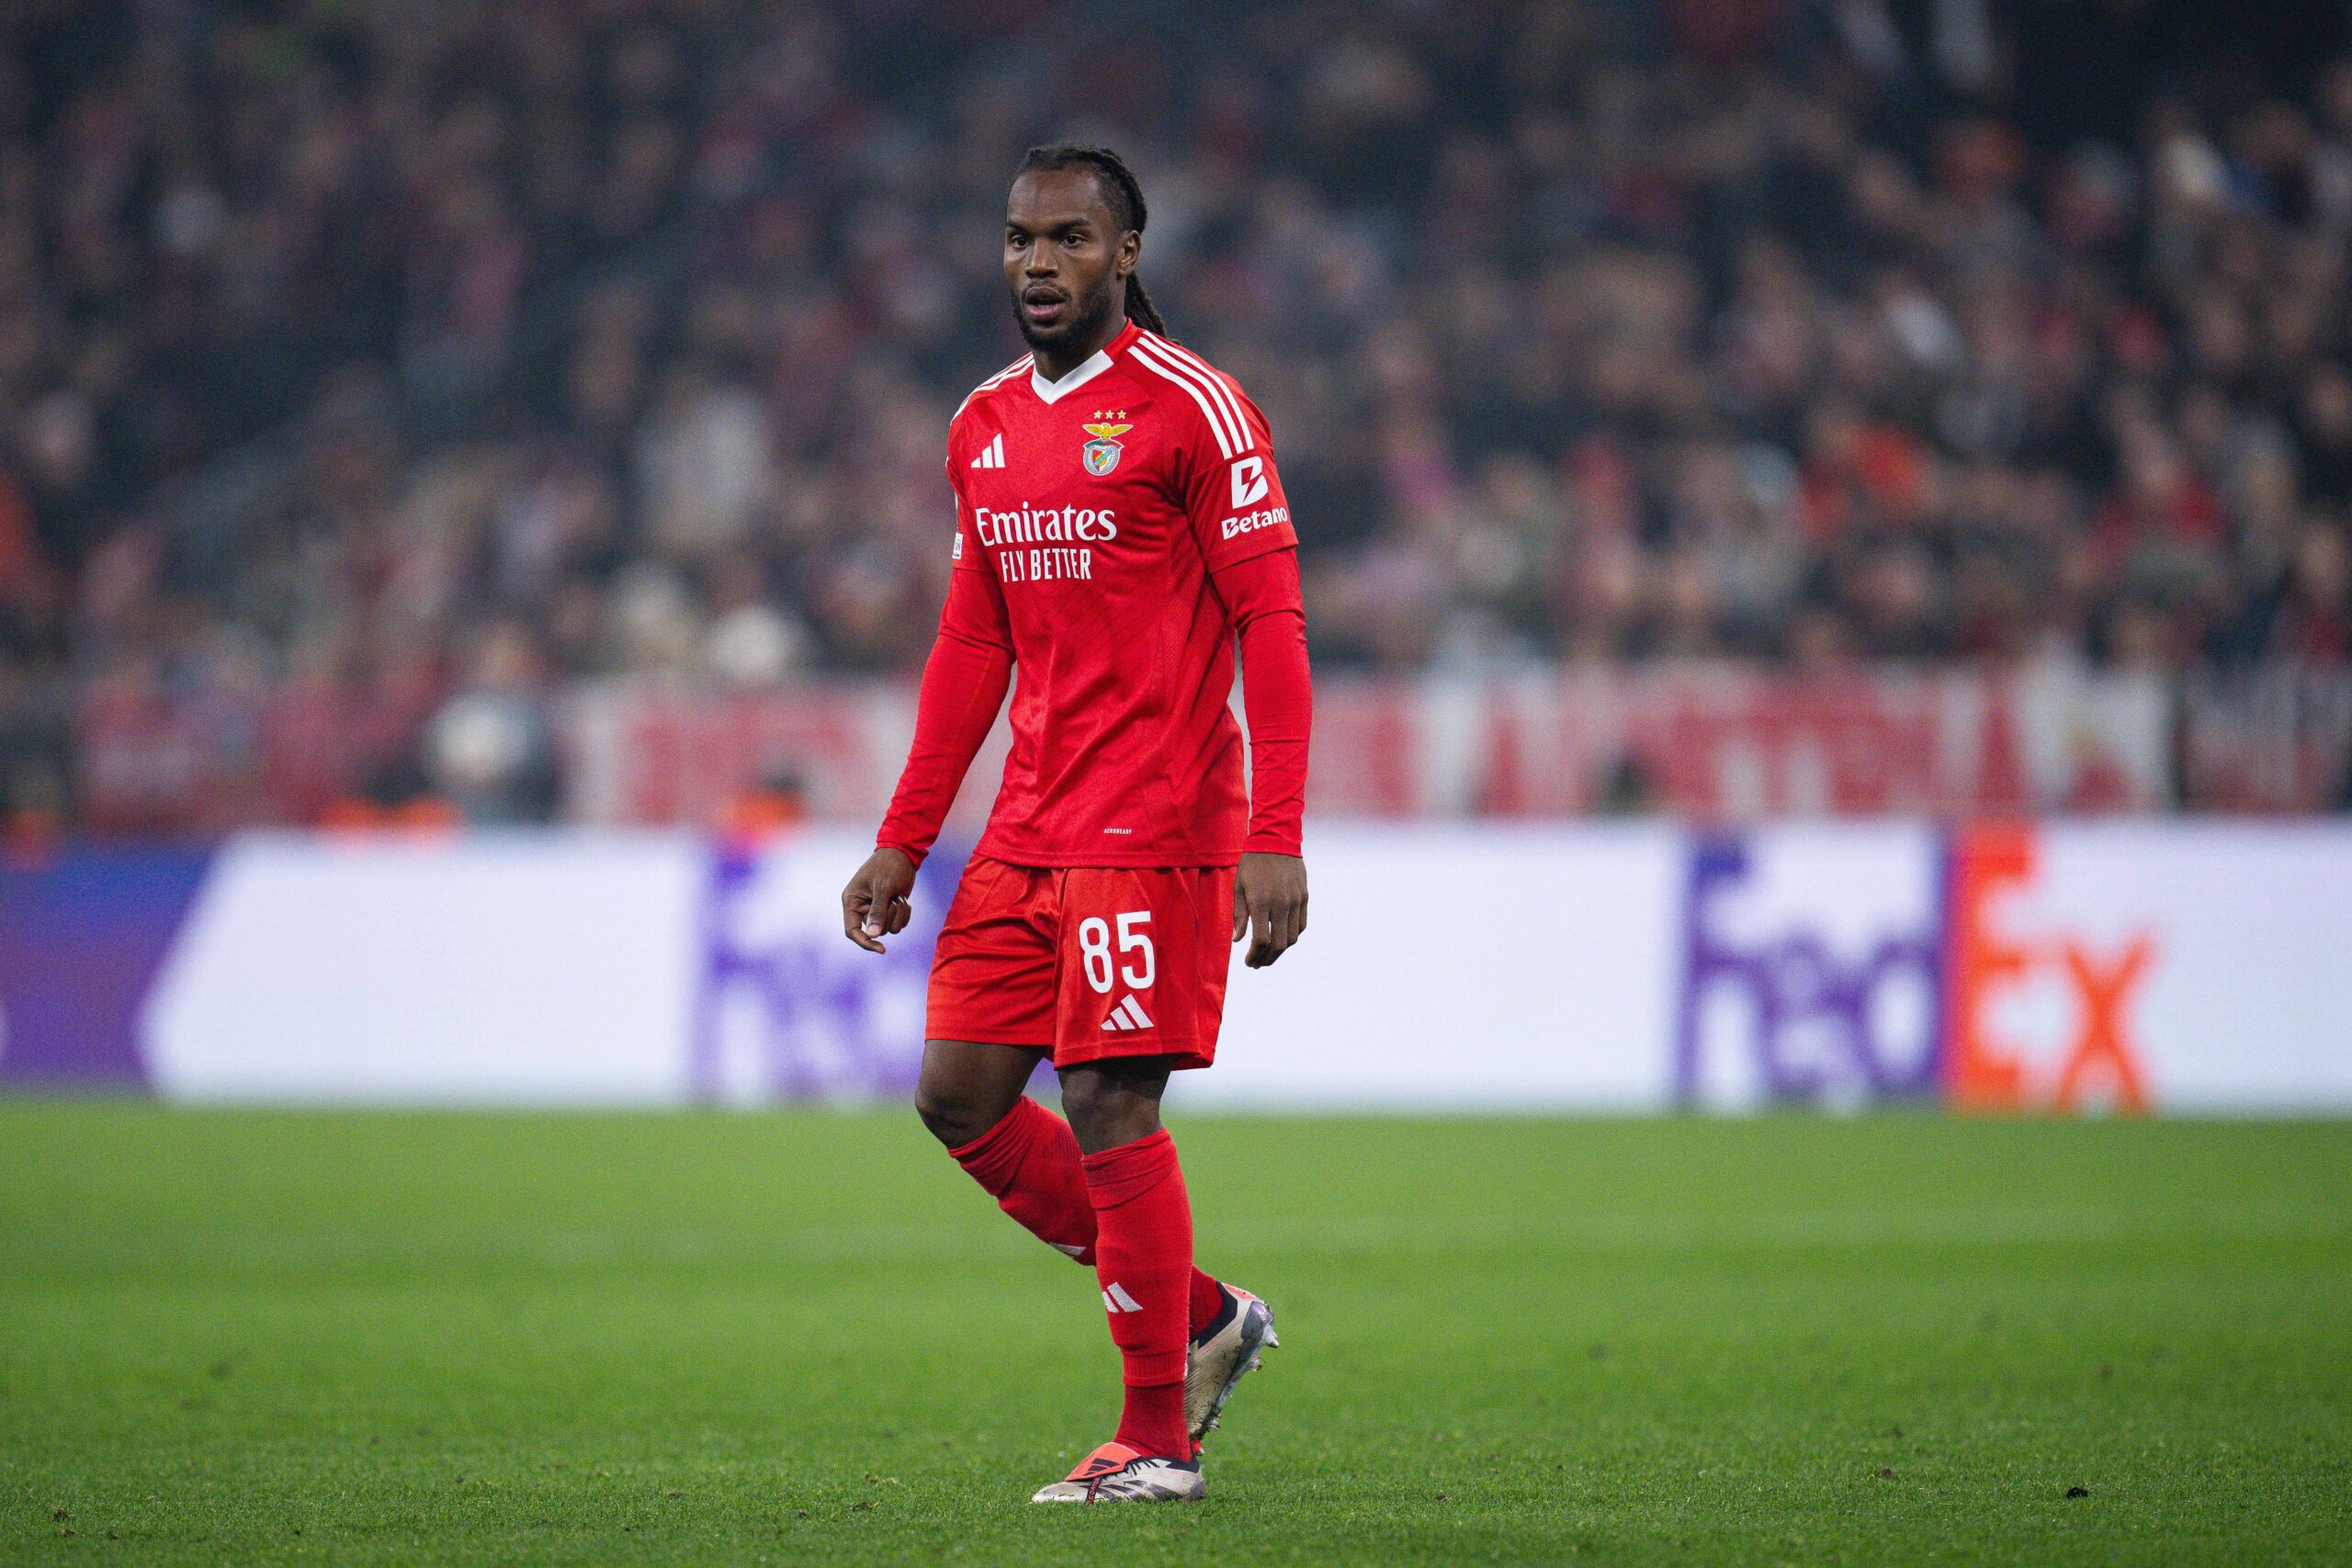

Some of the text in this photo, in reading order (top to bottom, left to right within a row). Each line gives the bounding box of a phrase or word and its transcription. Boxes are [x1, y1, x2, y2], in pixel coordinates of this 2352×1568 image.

[975, 501, 1117, 547] Emirates
[1221, 507, 1288, 540] Betano
[1000, 547, 1091, 582] FLY BETTER
[1079, 910, 1156, 994] 85
[1681, 825, 2155, 1110] FedEx
